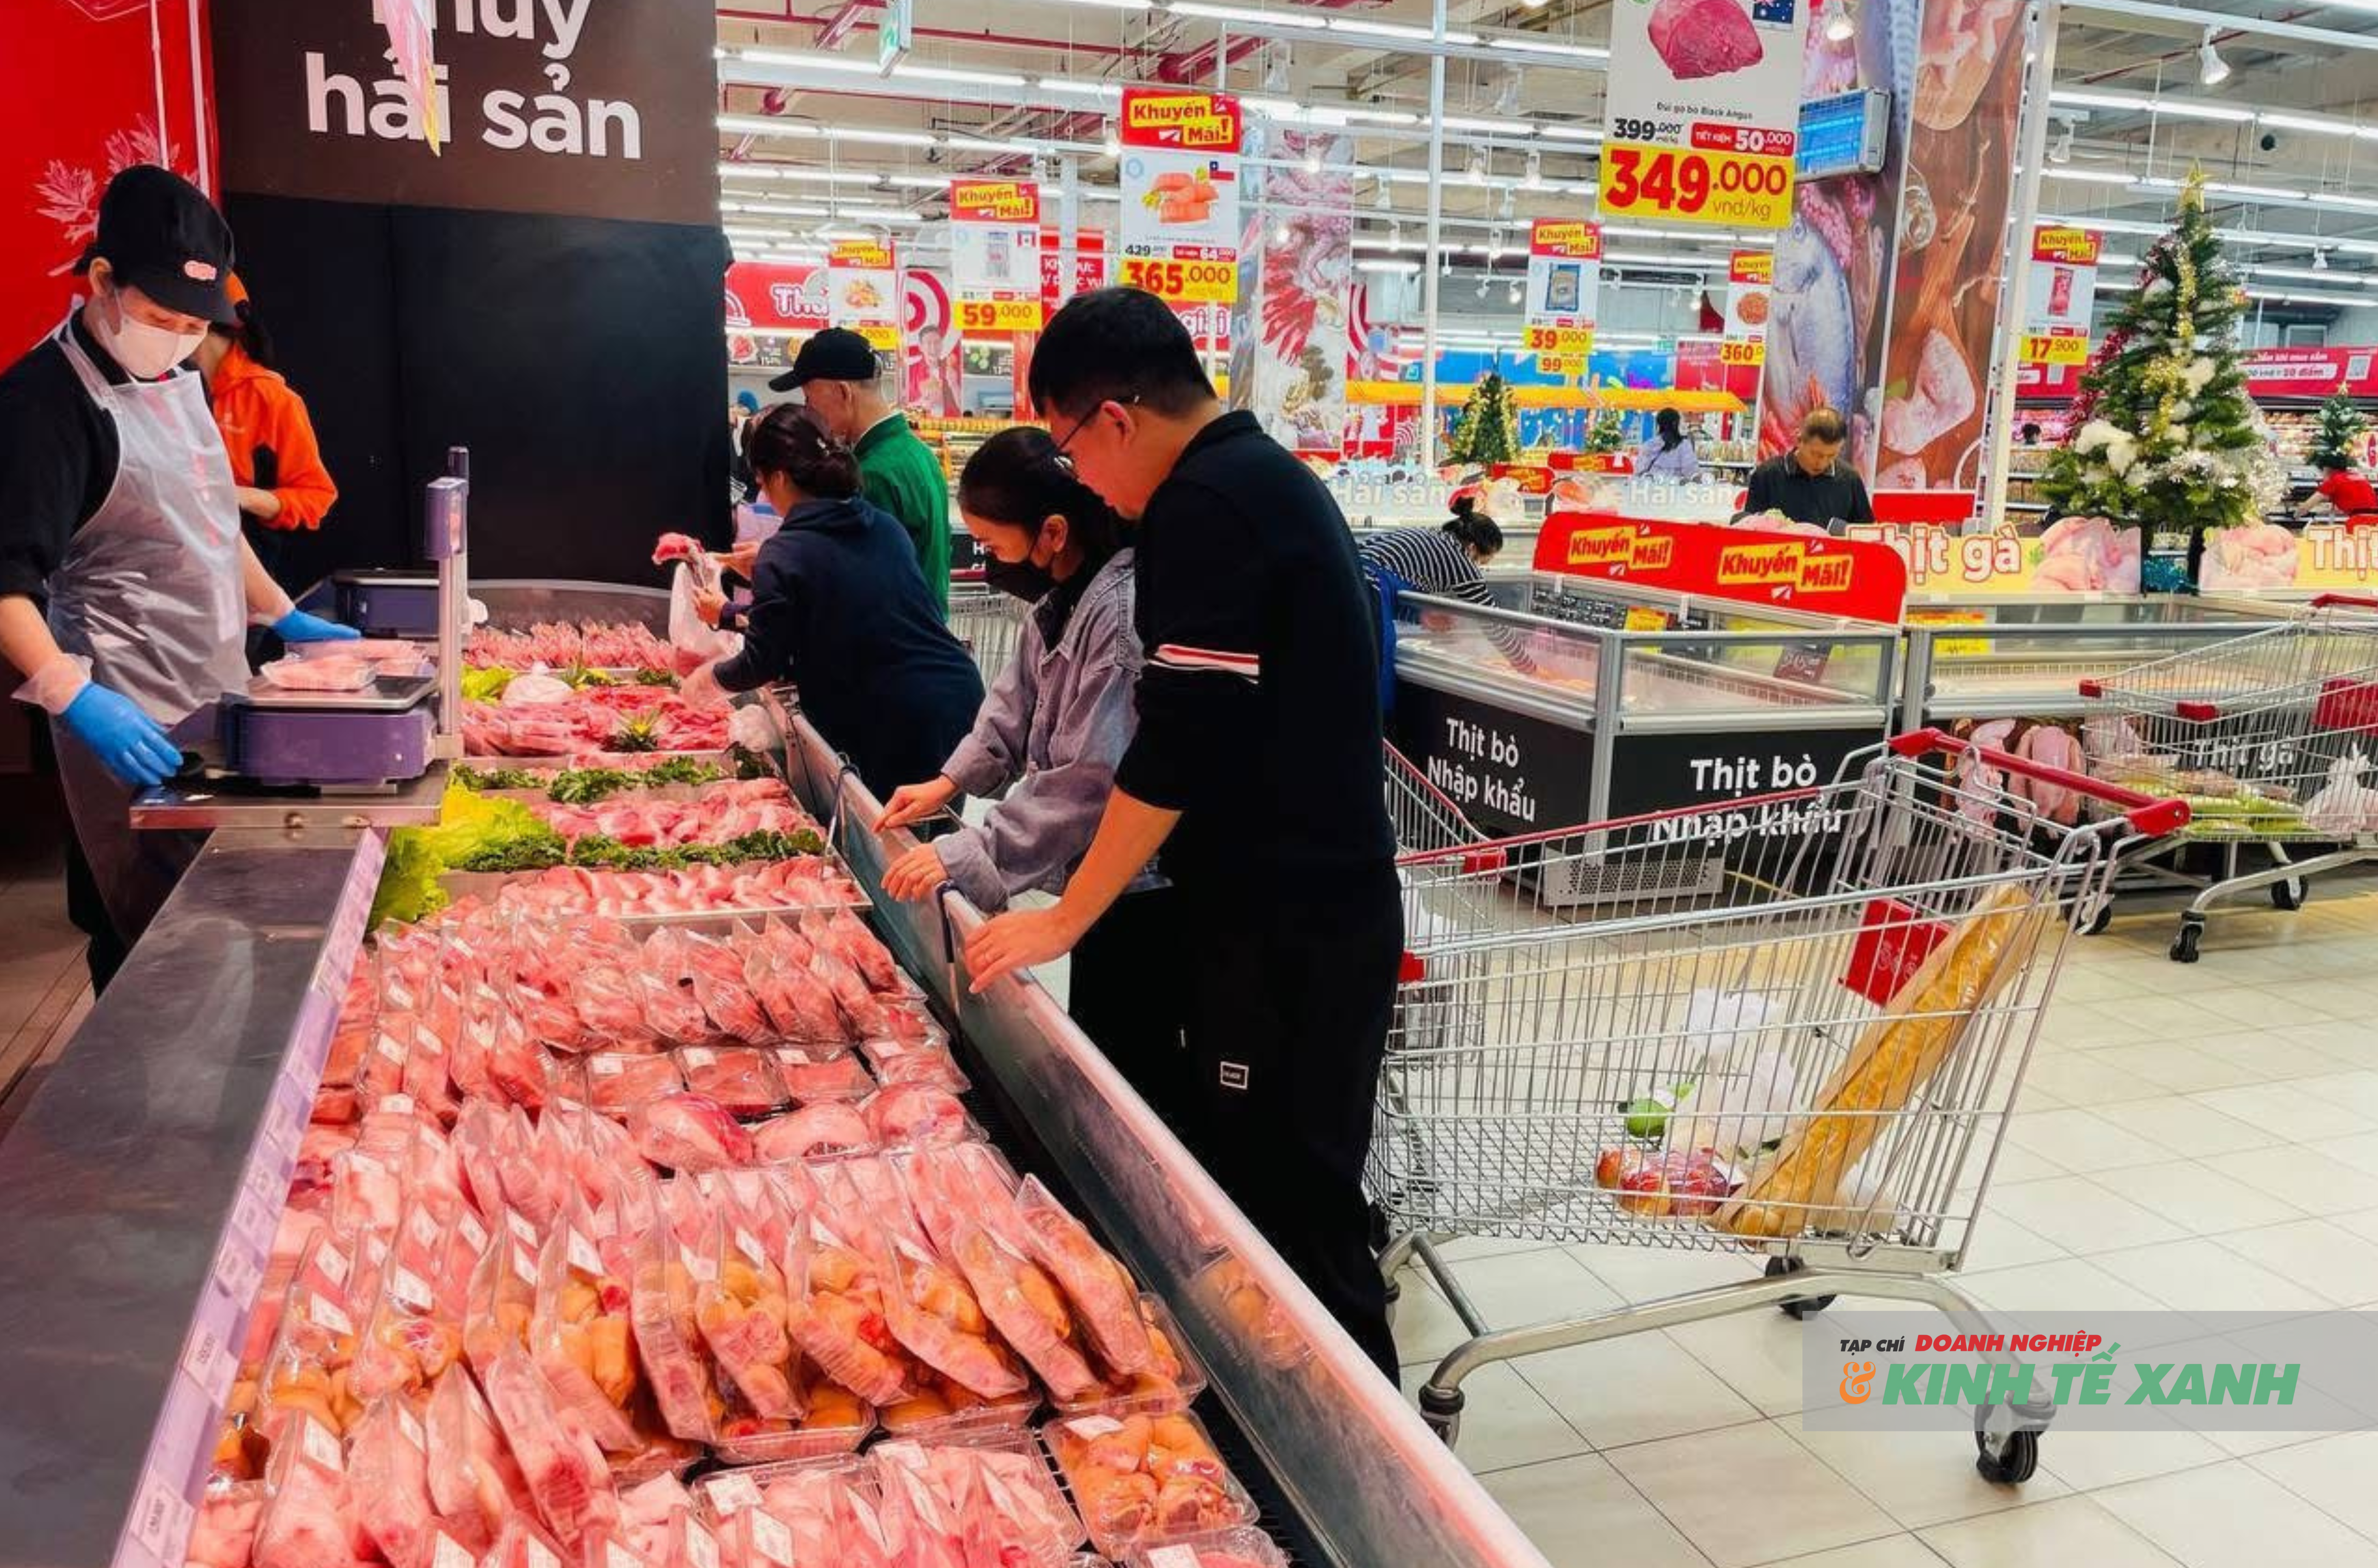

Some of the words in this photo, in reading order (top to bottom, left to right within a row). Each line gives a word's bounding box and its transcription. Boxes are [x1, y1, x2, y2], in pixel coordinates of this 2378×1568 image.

[482, 63, 641, 159] sản
[1134, 101, 1205, 121] Khuyến
[1713, 200, 1771, 221] vnd/kg
[1571, 531, 1629, 556] Khuyến
[1633, 538, 1671, 565] Mãi!
[1722, 546, 1797, 577] Khuyến
[1802, 557, 1849, 587] Mãi!
[1962, 523, 2021, 583] gà
[1446, 717, 1485, 761] Thịt
[1491, 730, 1519, 768] bò
[1427, 755, 1478, 804] Nhập
[1484, 774, 1535, 822] khẩu
[1690, 757, 1760, 797] Thịt
[1771, 754, 1817, 788] bò
